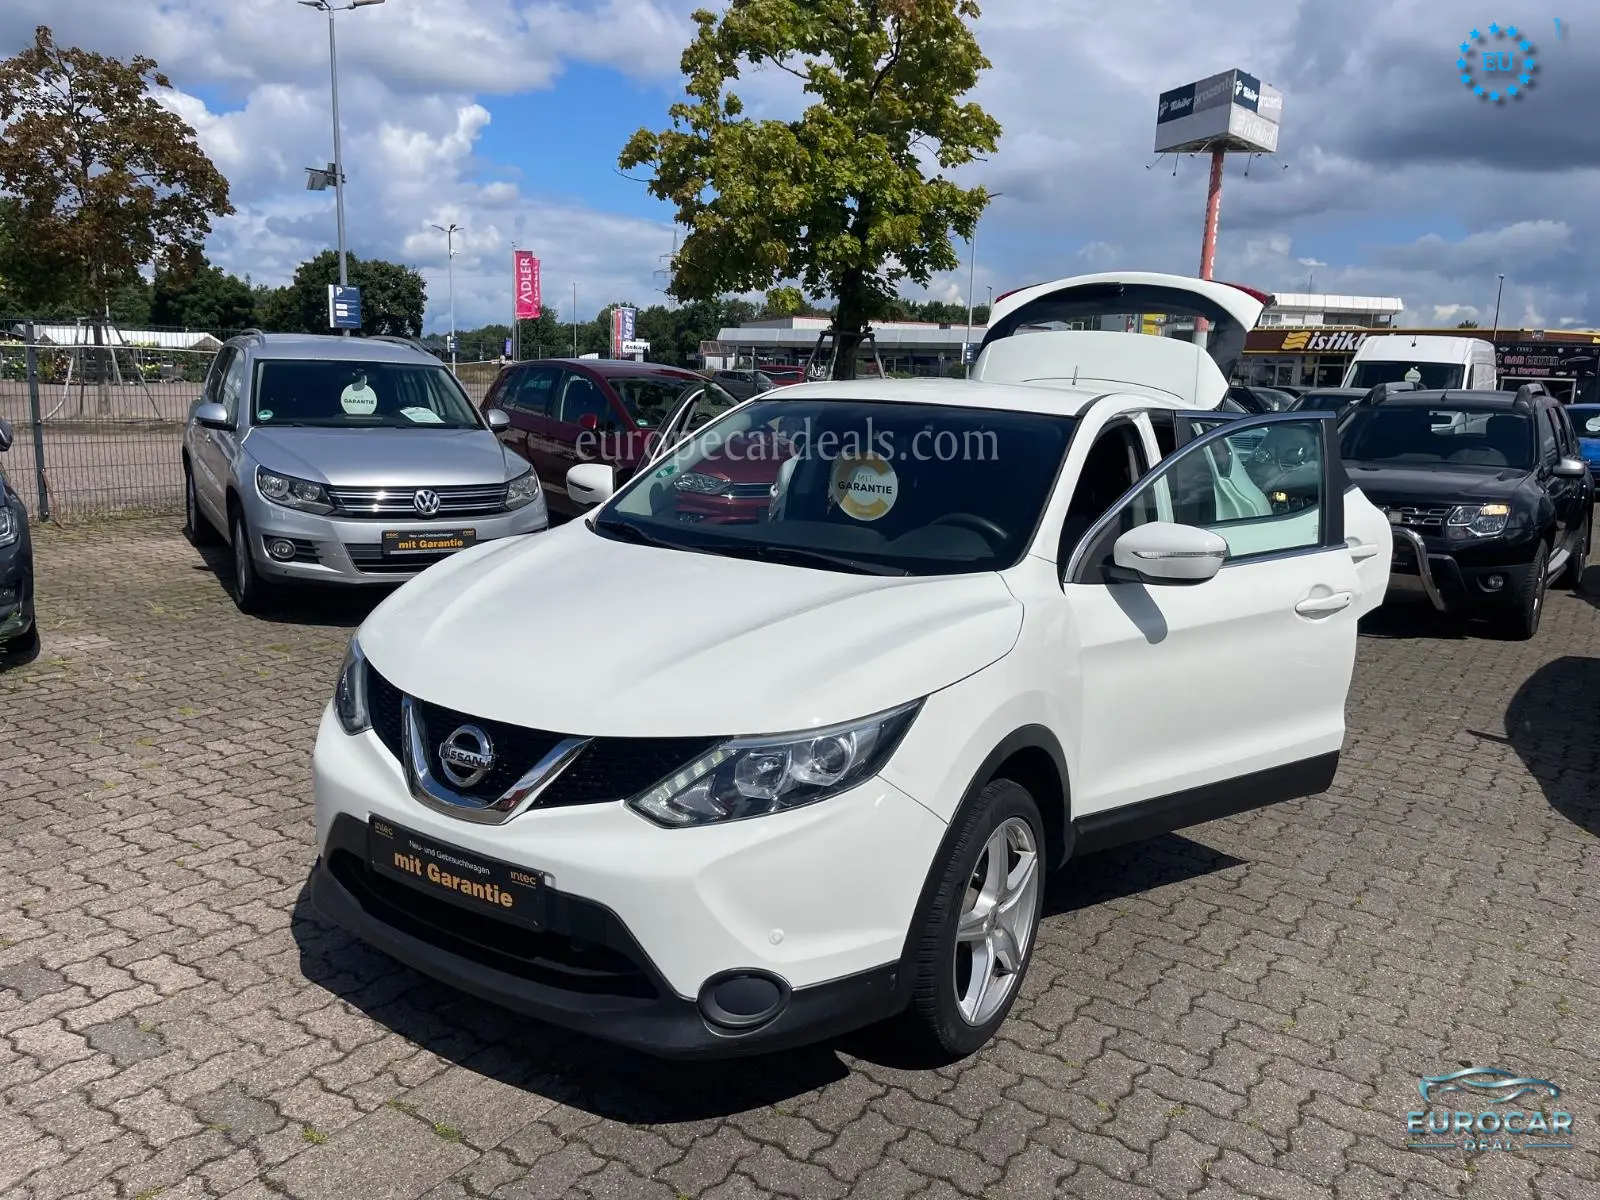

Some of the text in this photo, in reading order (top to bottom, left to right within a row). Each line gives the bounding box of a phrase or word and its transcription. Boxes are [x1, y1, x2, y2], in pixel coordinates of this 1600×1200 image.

[520, 257, 532, 303] ADLER
[336, 287, 343, 296] P
[1307, 331, 1368, 350] istikb
[838, 481, 893, 494] GARANTIE
[398, 538, 464, 549] mit Garantie
[394, 851, 513, 908] mit Garantie
